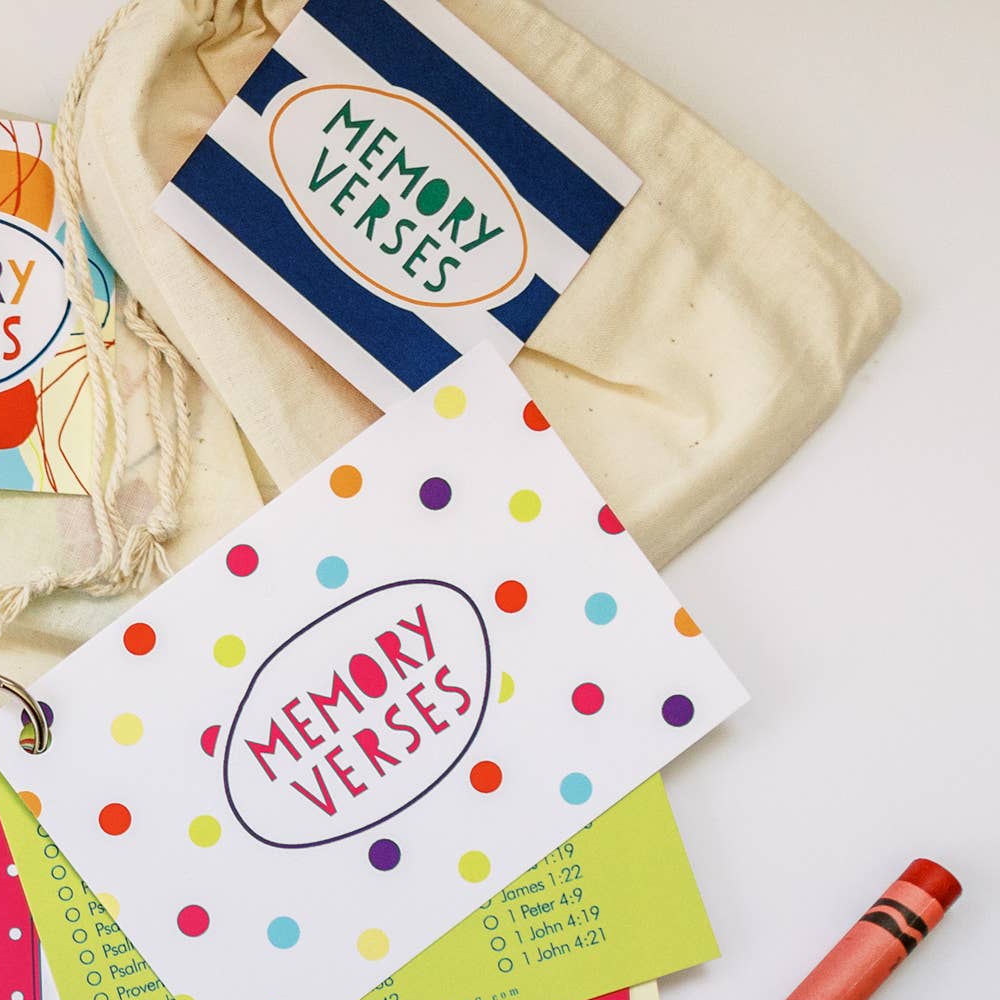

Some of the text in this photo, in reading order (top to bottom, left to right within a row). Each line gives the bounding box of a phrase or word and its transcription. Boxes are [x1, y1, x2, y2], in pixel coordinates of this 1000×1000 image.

[322, 98, 505, 253] MEMORY
[308, 146, 461, 293] VERSES
[244, 604, 436, 782] MEMORY
[290, 664, 471, 817] VERSES
[501, 864, 584, 904] James 1:22
[508, 887, 583, 923] 1 Peter 4:9
[515, 905, 600, 944] 1 John 4:19
[522, 927, 606, 965] 1 John 4:21
[116, 979, 166, 1000] Prover
